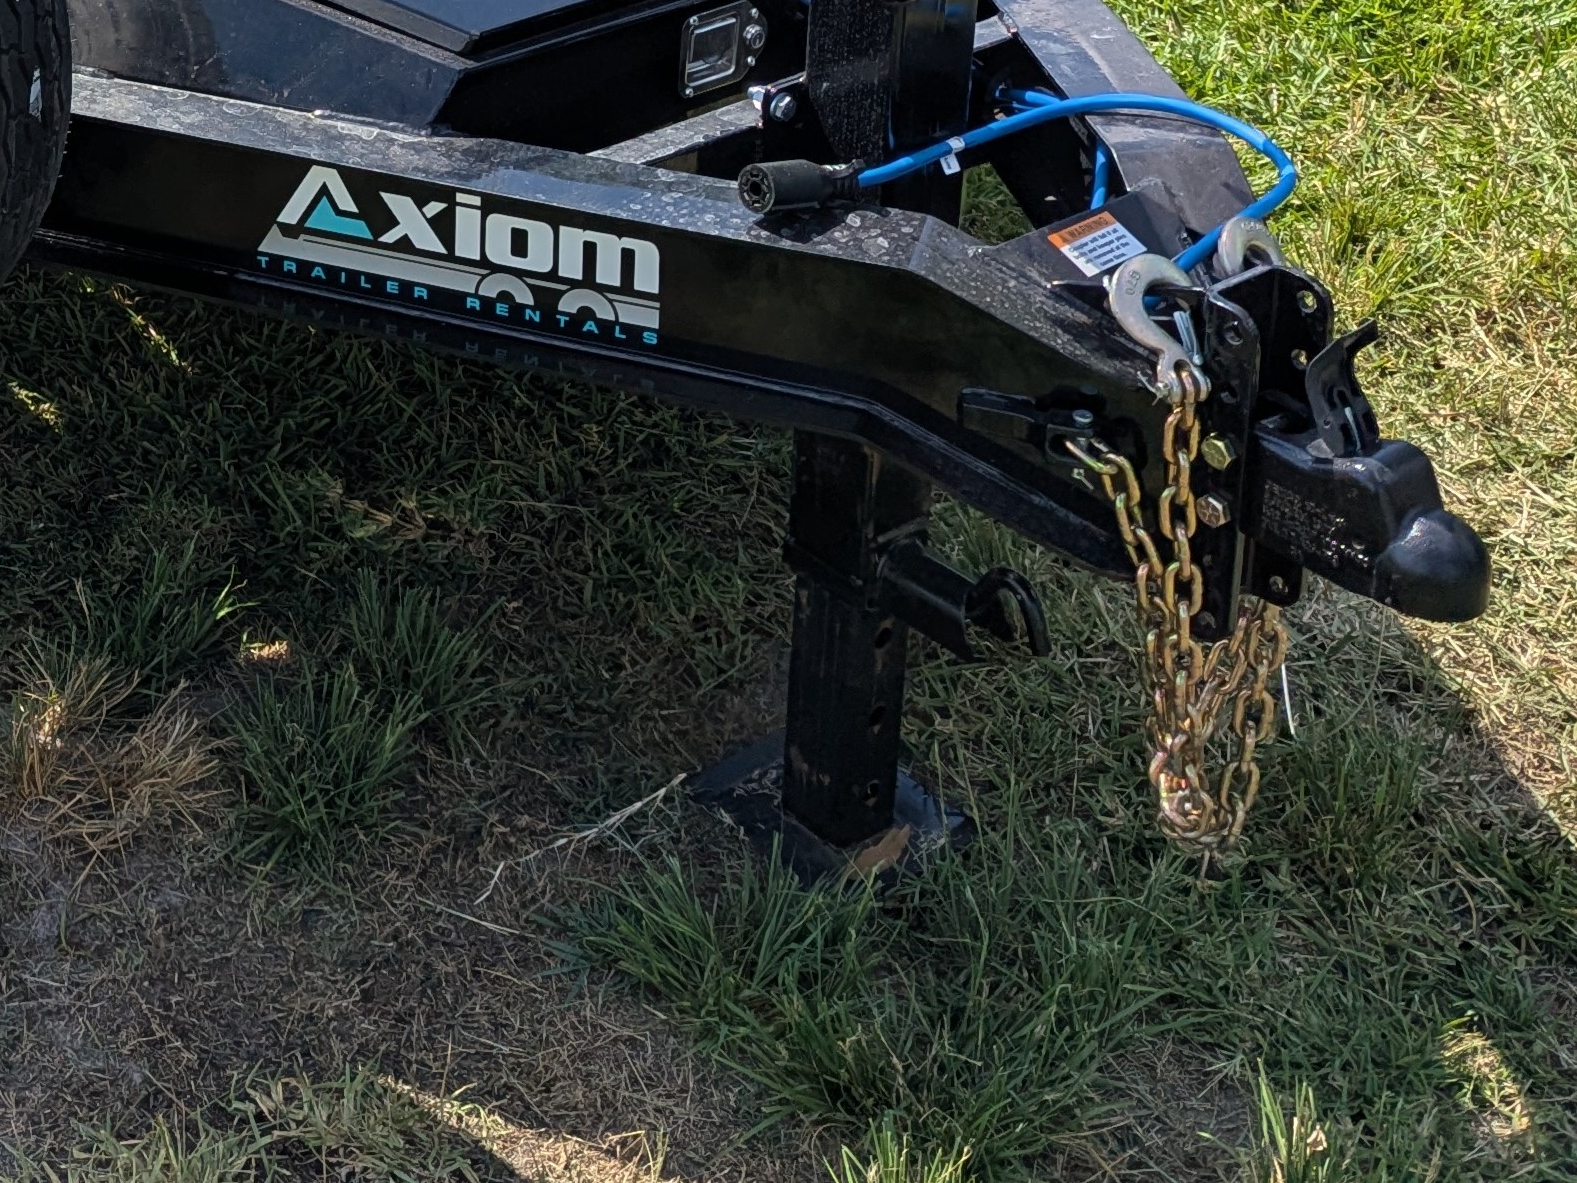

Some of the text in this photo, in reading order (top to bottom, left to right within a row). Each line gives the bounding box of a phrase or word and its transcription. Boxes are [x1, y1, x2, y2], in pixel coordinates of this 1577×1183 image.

[276, 164, 660, 294] Axiom
[257, 256, 658, 345] TRAILER RENTALS
